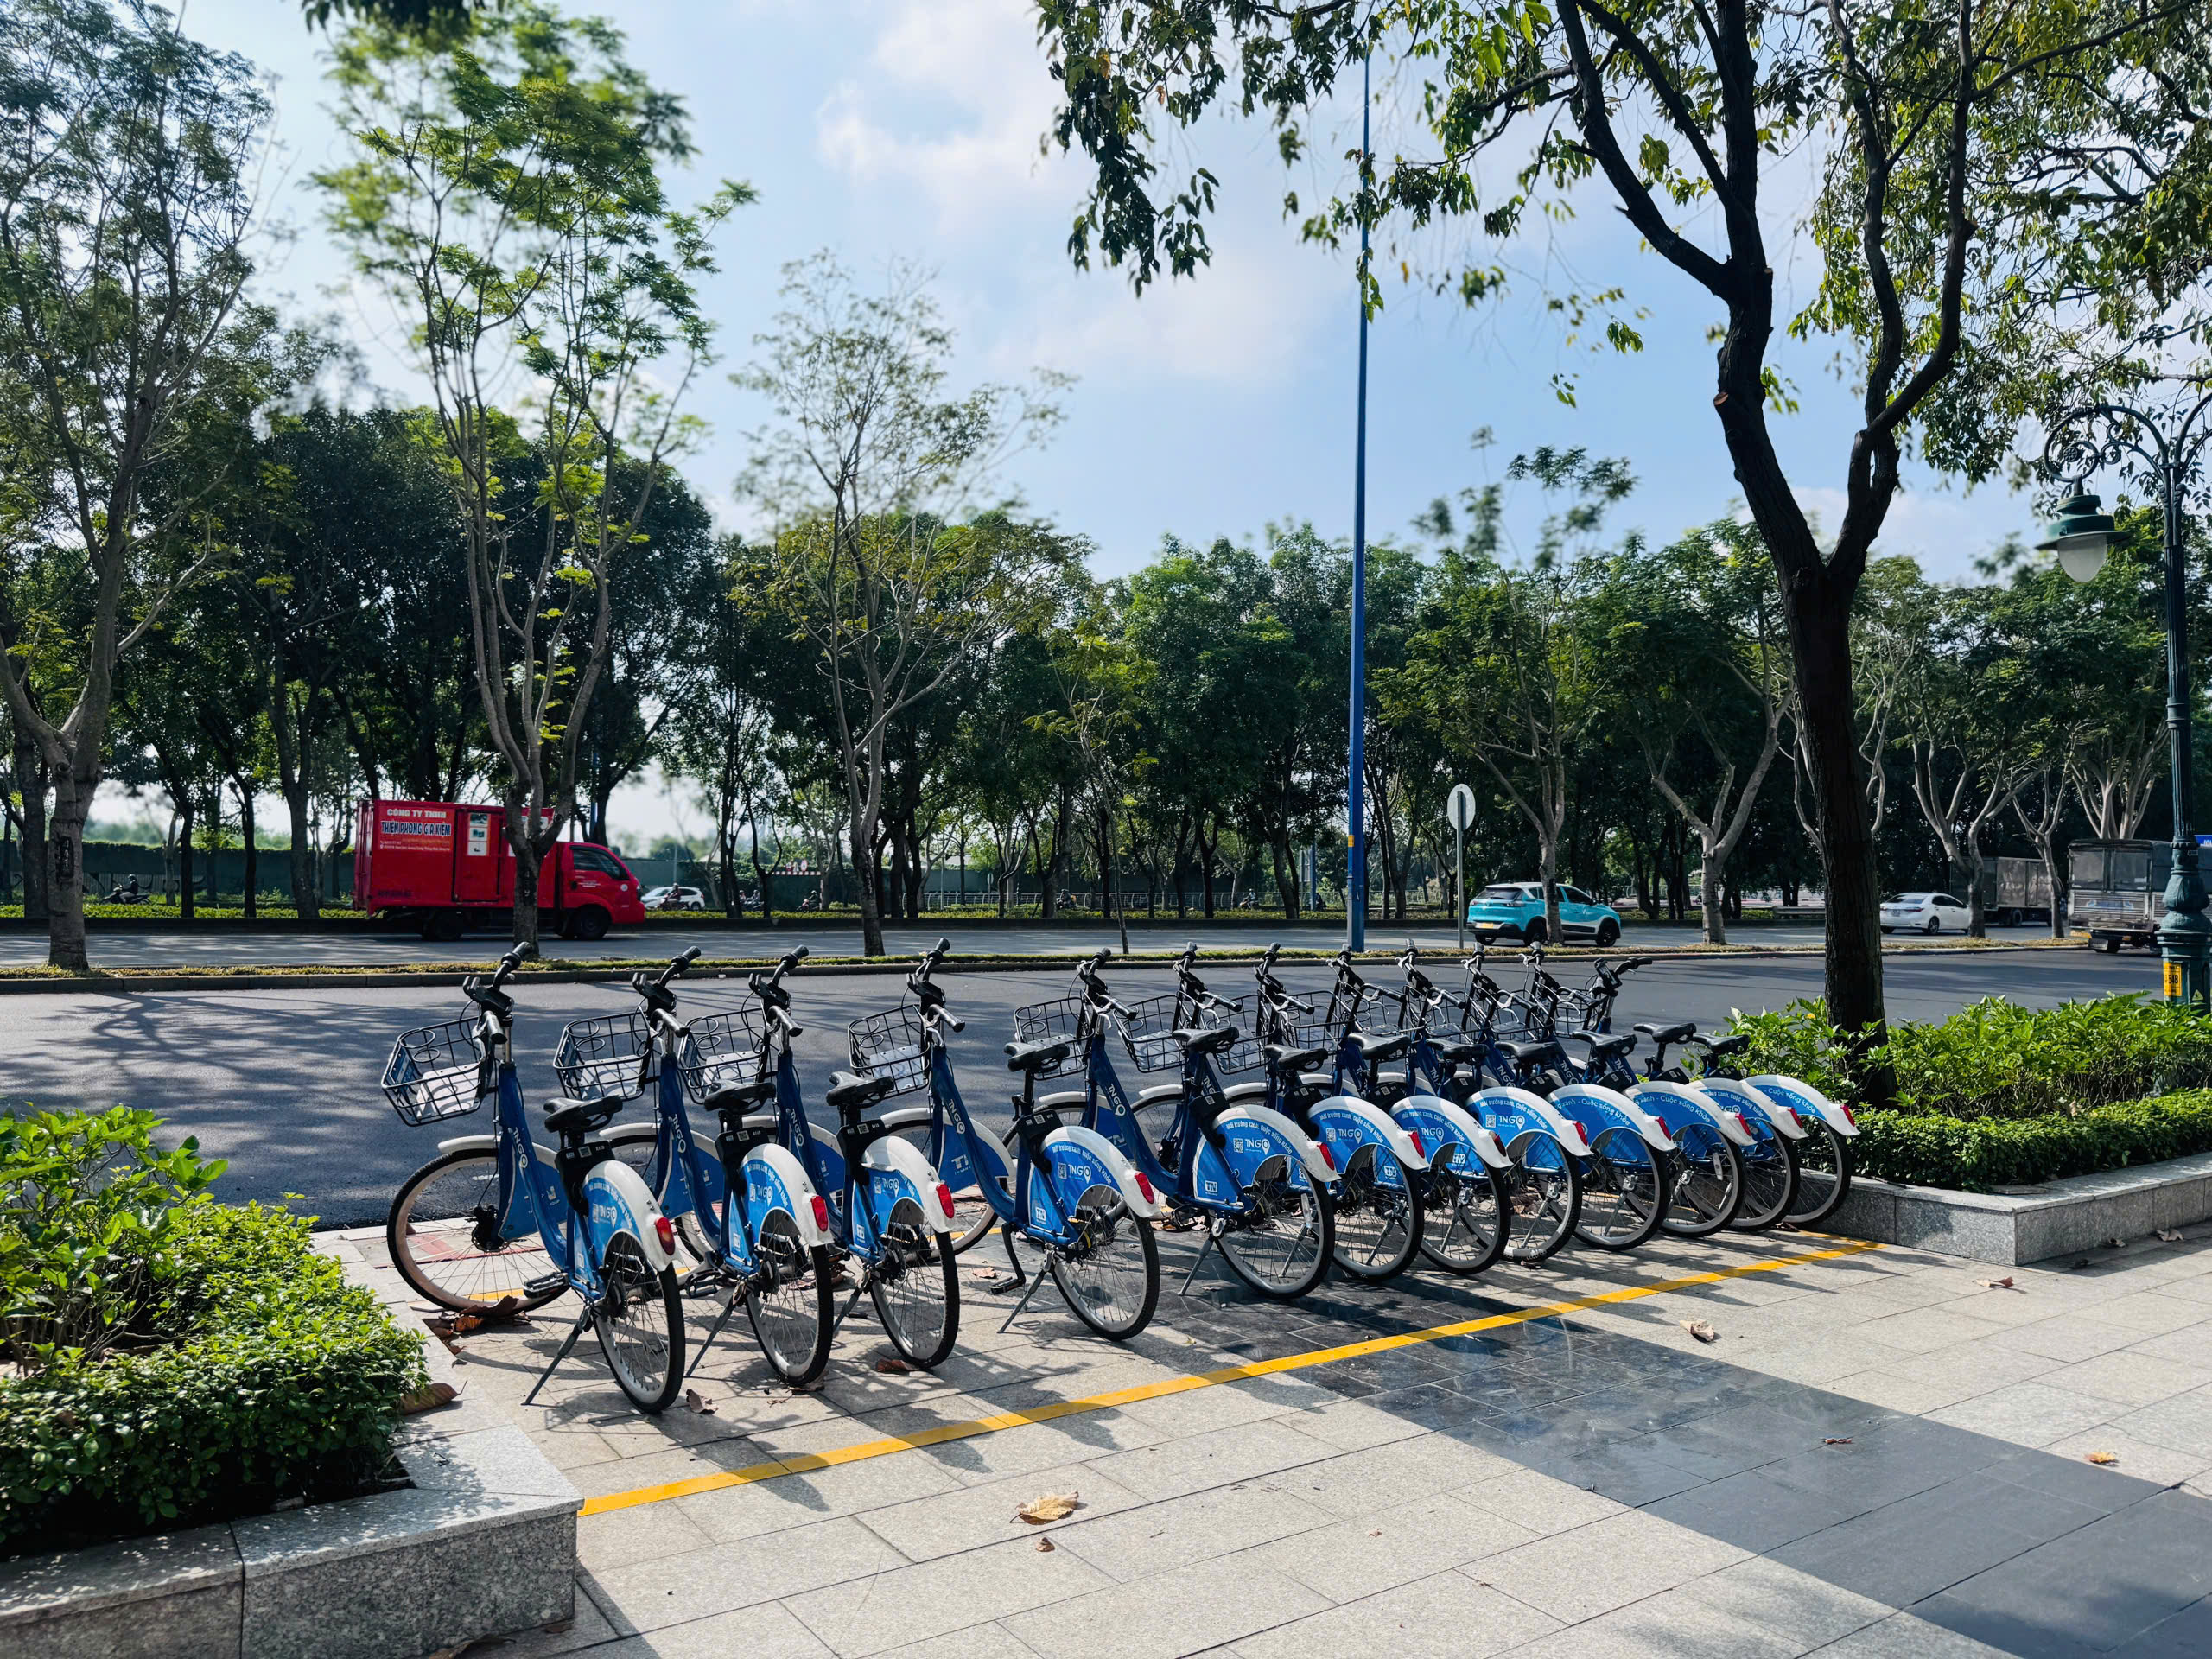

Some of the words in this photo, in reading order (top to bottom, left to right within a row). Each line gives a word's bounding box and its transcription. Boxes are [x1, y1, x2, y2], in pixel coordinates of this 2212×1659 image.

[1108, 1083, 1126, 1116] TNGO
[1660, 1095, 1678, 1105] Cuộc
[1678, 1100, 1695, 1113] sống
[1768, 1087, 1785, 1096] Cuộc
[1785, 1091, 1801, 1104] sống
[1581, 1098, 1598, 1107] Cuộc
[1599, 1103, 1615, 1116] sống
[948, 1100, 966, 1135] TNGO
[1497, 1115, 1526, 1130] TNGO
[671, 1114, 687, 1154] TNGO
[1337, 1128, 1363, 1144] TNGO
[1420, 1127, 1445, 1142] TNGO
[1244, 1137, 1271, 1155] TNGO
[1068, 1164, 1091, 1184] TNGO
